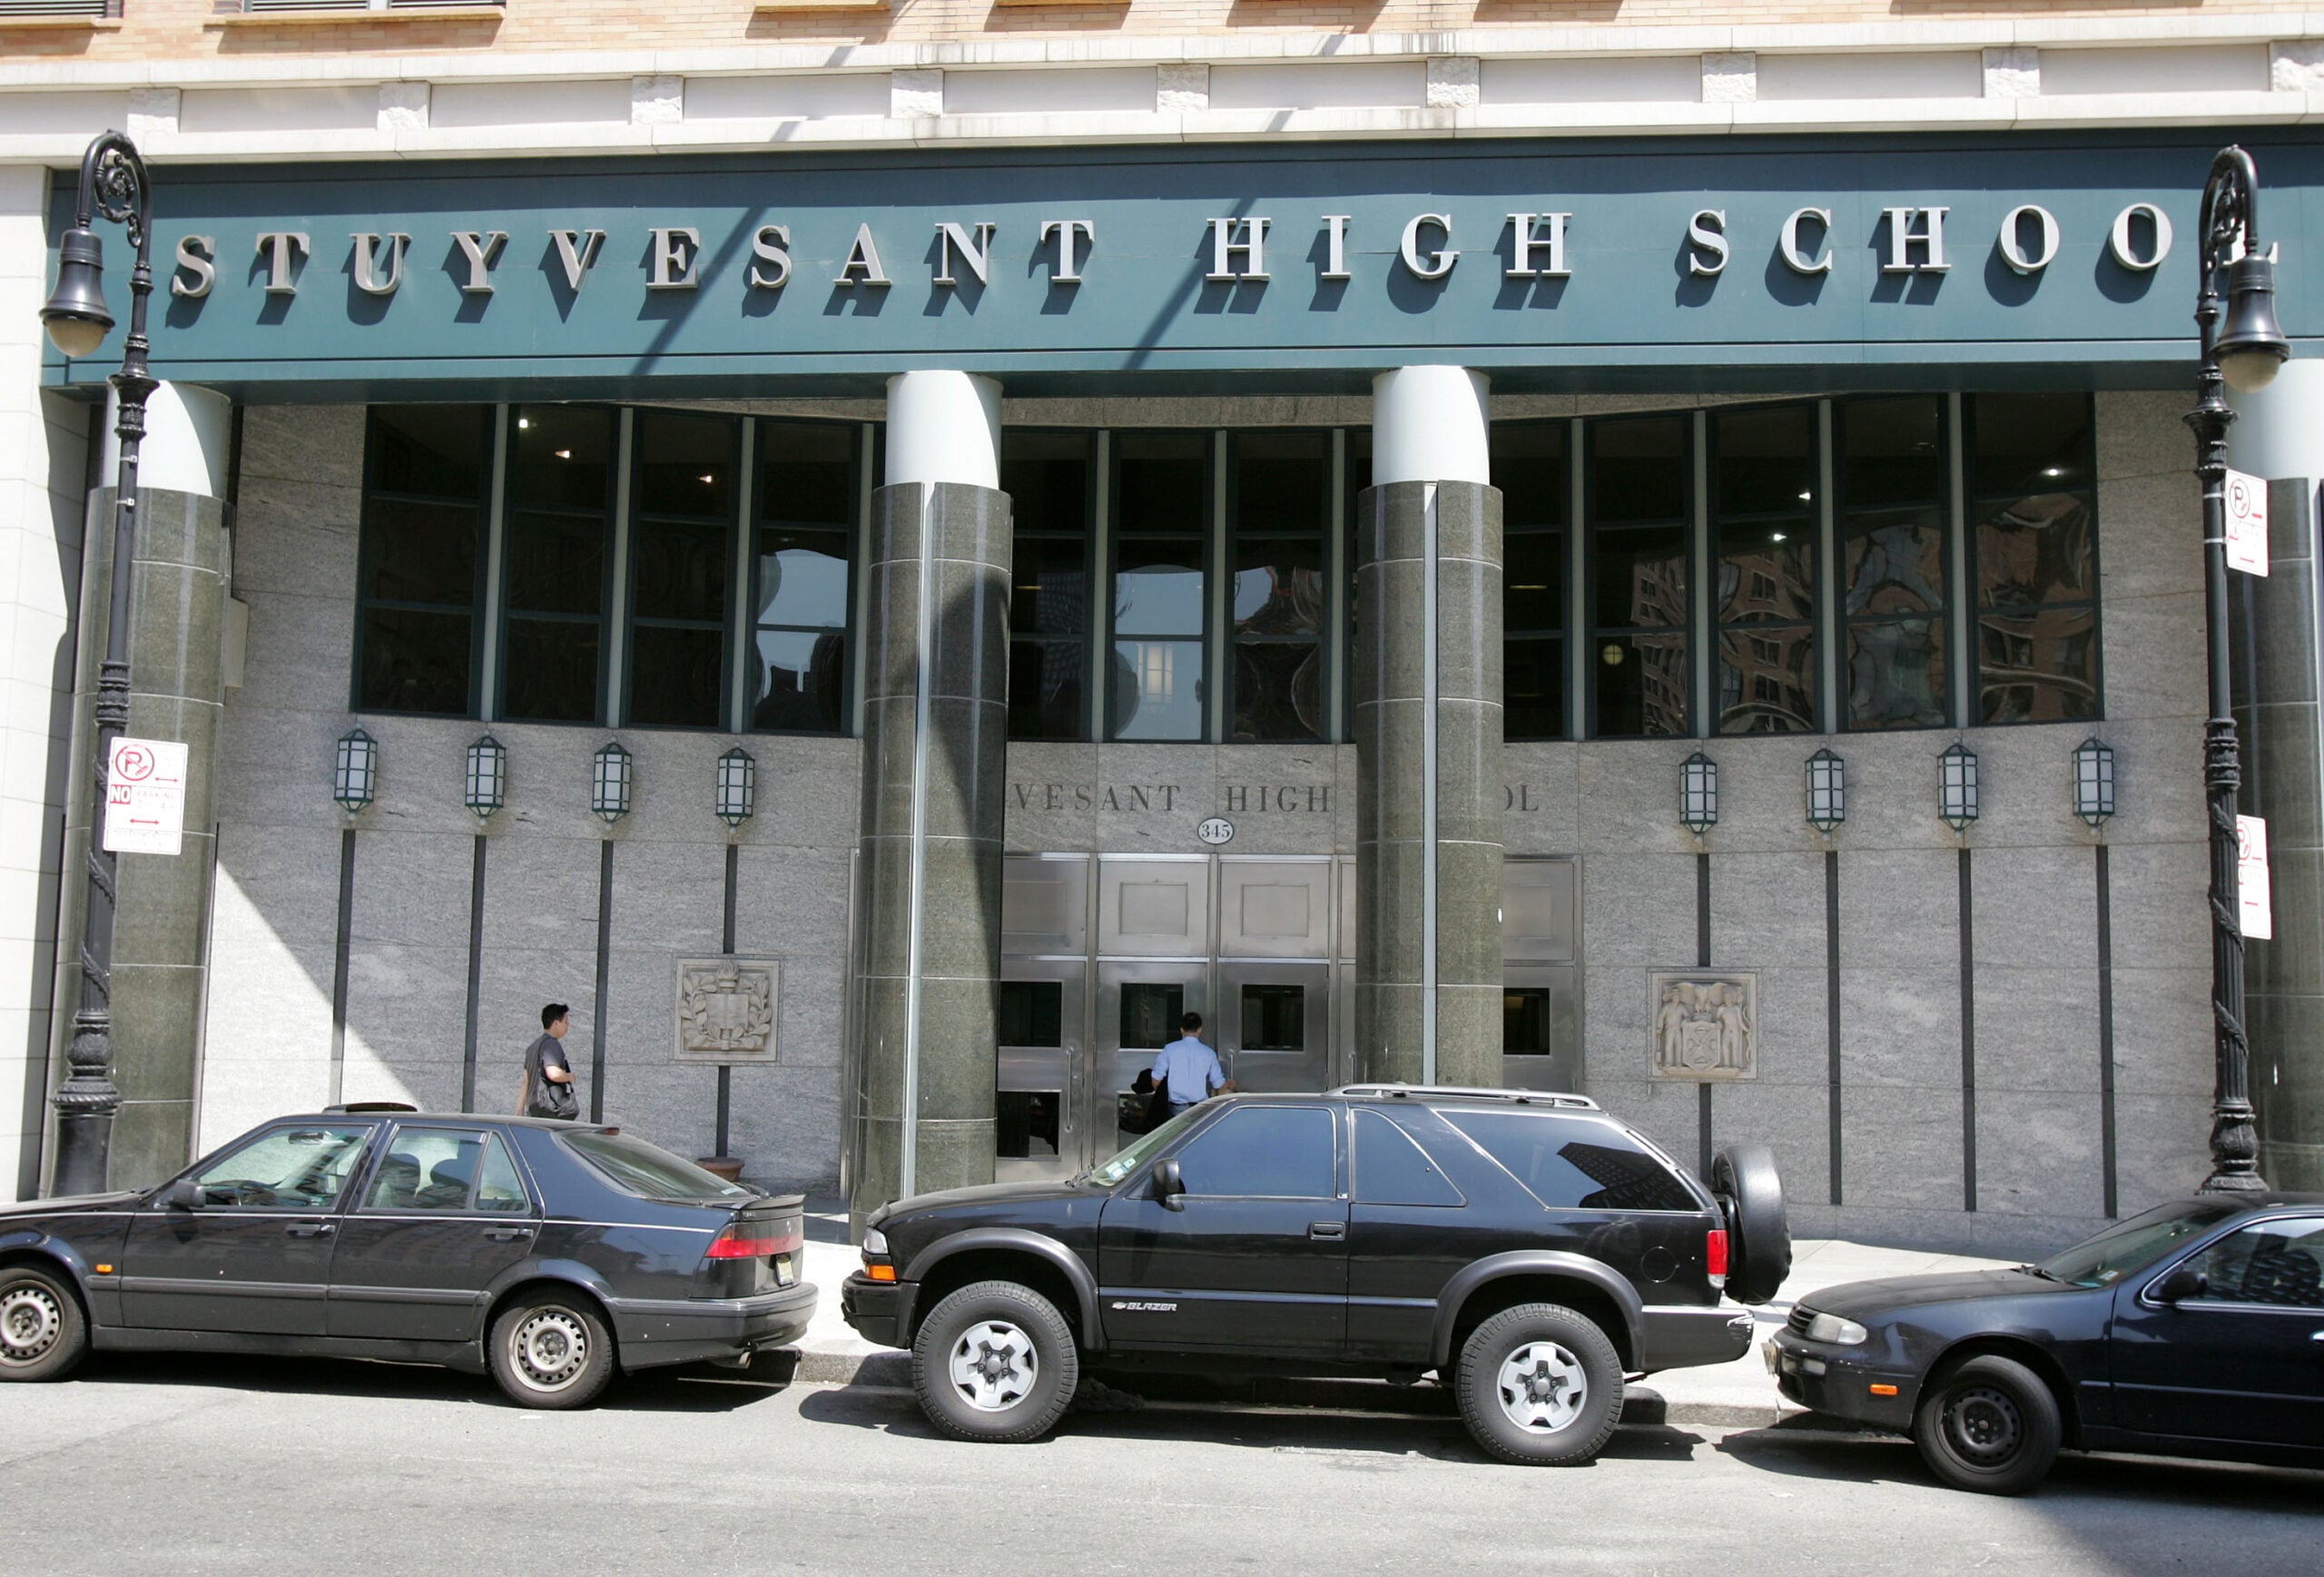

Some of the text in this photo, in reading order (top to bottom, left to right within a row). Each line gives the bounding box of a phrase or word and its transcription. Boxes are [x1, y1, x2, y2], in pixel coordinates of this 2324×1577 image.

[172, 220, 1095, 299] STUYVESANT
[1206, 212, 1573, 282] HIGH
[110, 785, 131, 803] NO
[1226, 784, 1331, 813] HIGH
[1200, 823, 1231, 839] 345
[1126, 1301, 1177, 1312] BLAZER
